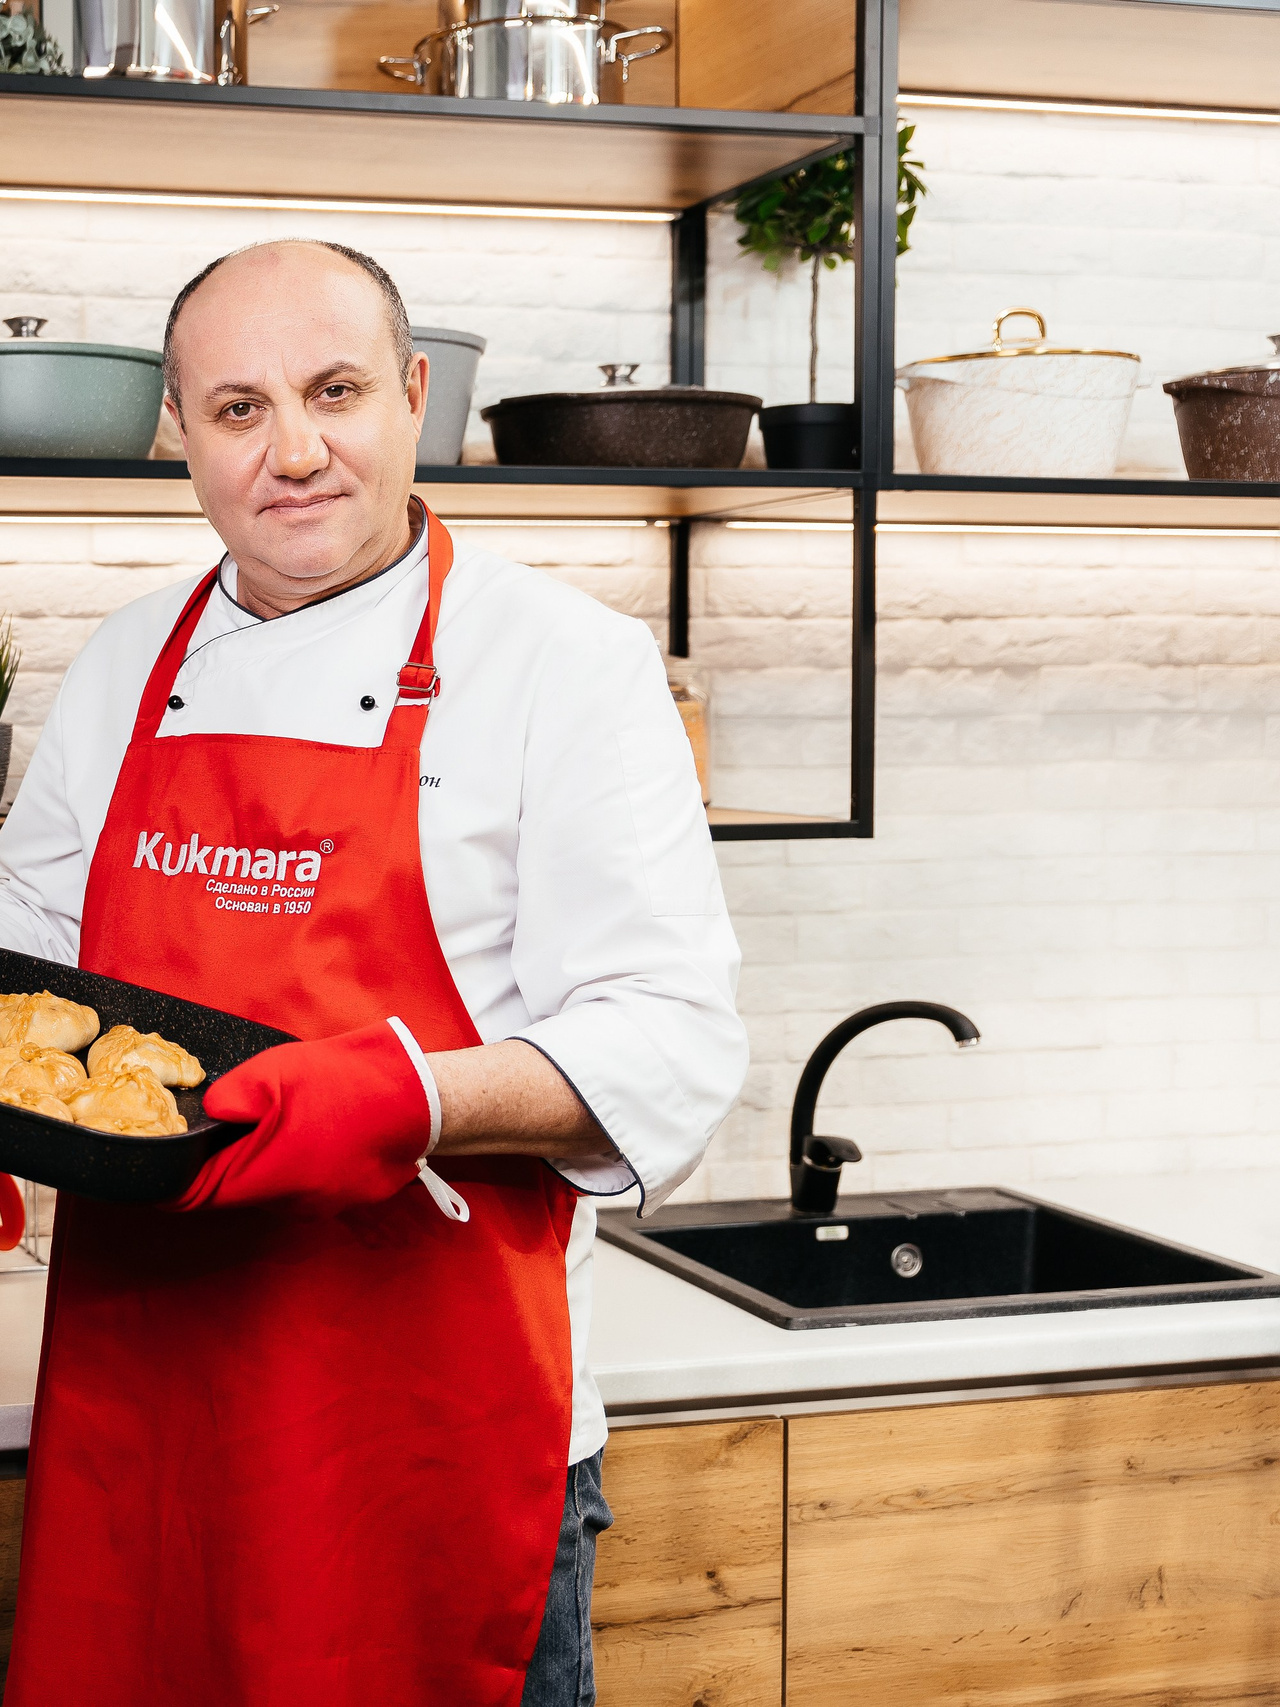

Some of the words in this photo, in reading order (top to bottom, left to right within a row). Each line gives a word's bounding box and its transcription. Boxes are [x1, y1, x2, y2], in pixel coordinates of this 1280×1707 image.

[419, 775, 441, 788] он
[205, 879, 258, 896] Сделано
[260, 884, 269, 896] в
[271, 884, 315, 898] России
[215, 896, 269, 914] Основан
[272, 903, 281, 914] в
[284, 901, 312, 914] 1950
